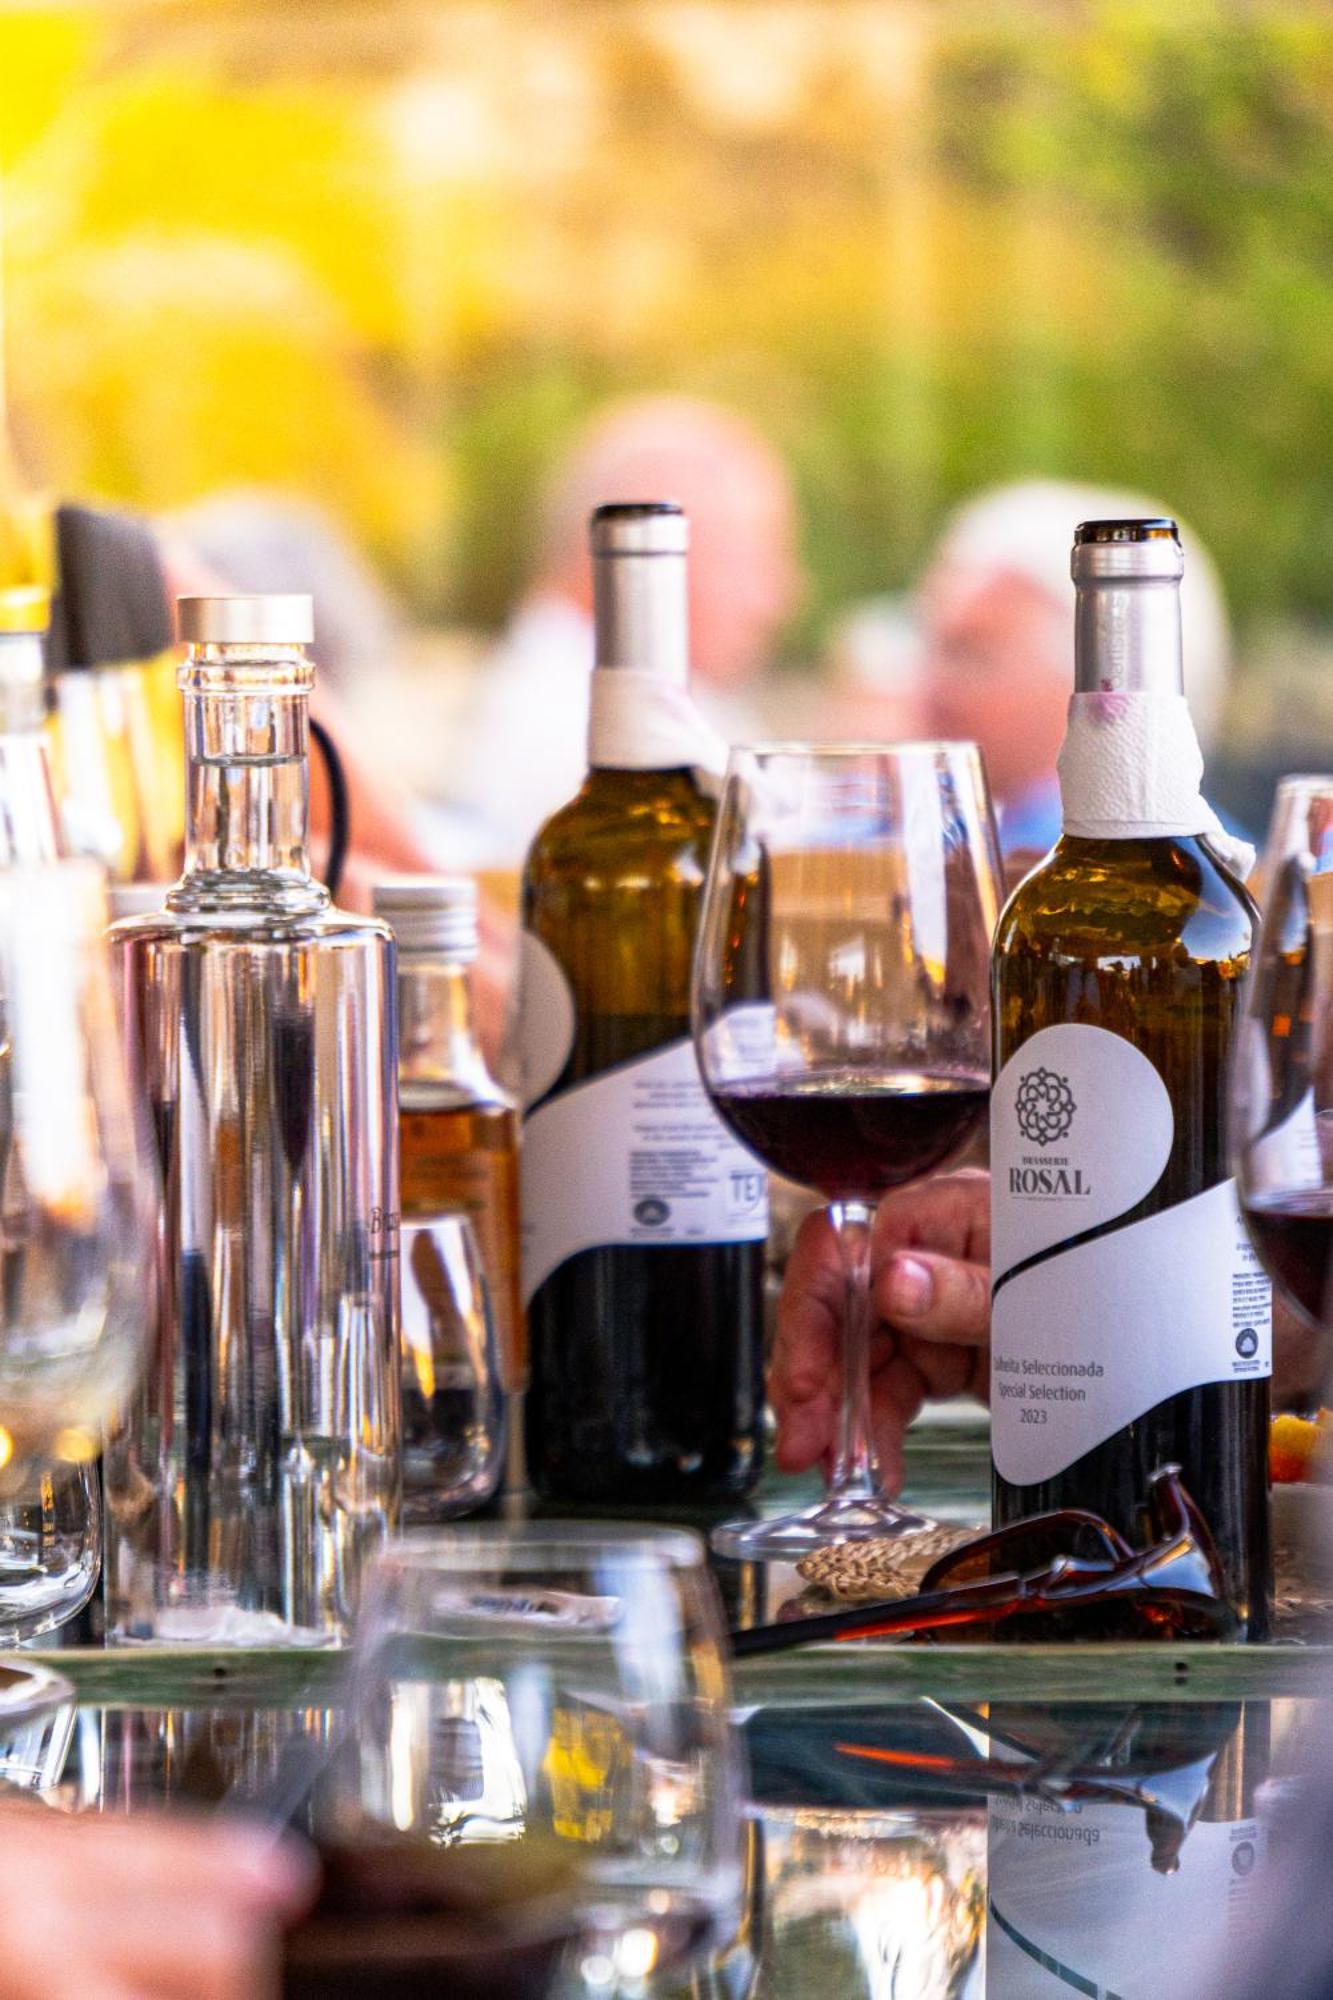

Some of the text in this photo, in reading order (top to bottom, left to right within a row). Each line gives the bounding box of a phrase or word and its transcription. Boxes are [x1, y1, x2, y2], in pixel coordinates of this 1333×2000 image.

[1009, 1167, 1091, 1195] ROSAL
[1021, 1360, 1104, 1377] Seleccionada
[1028, 1384, 1086, 1401] Selection
[1020, 1408, 1047, 1424] 2023
